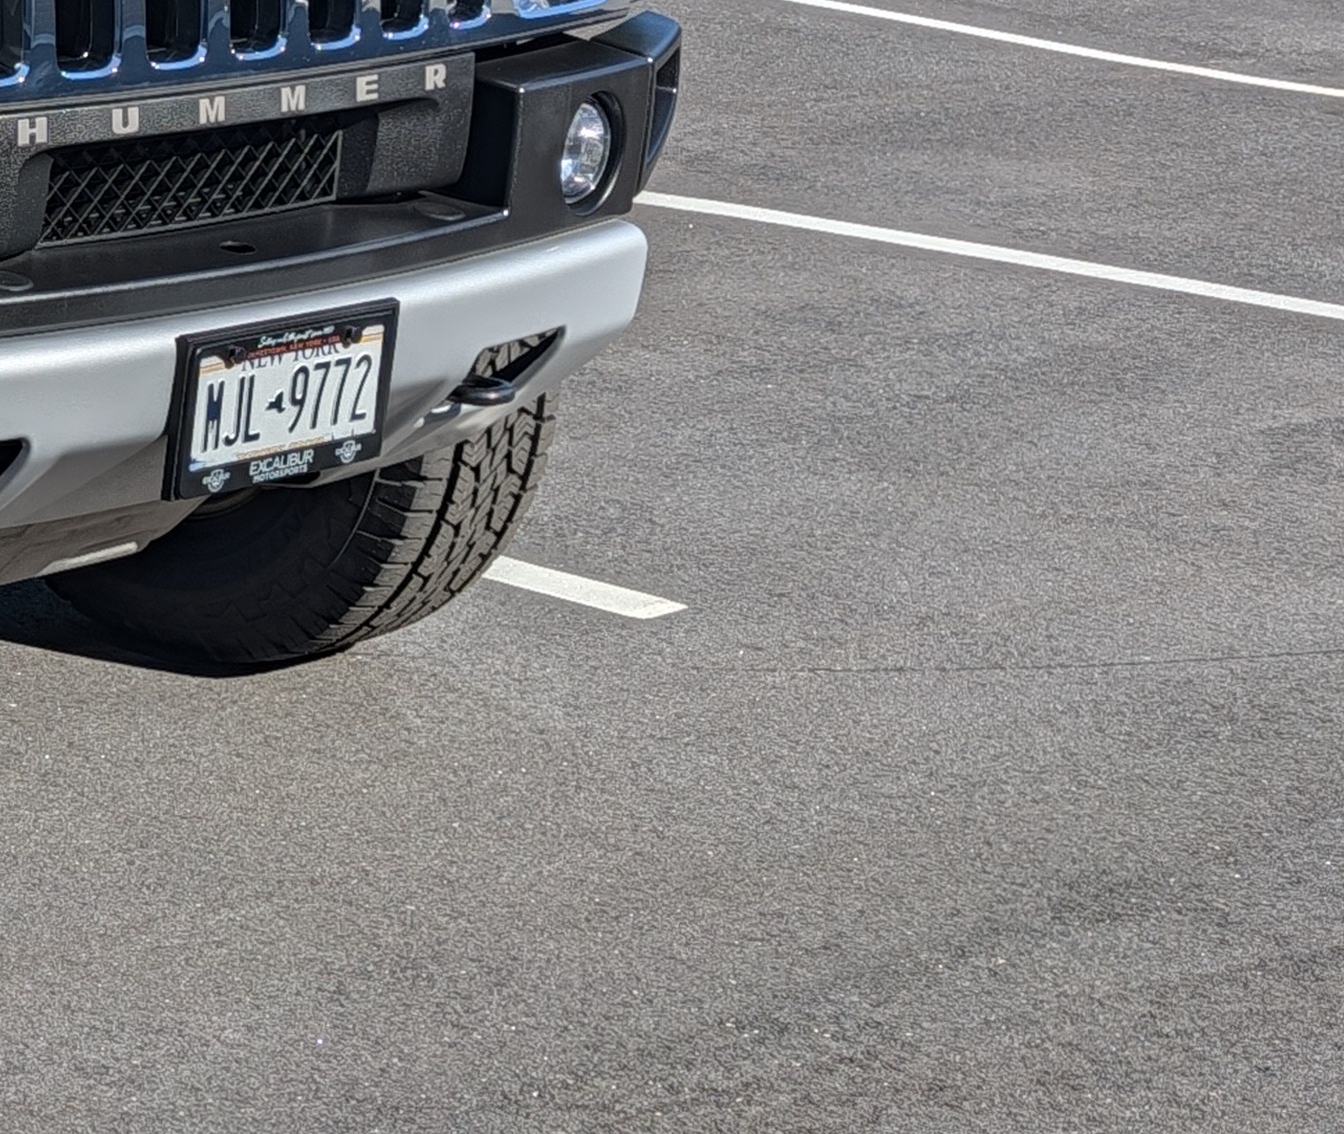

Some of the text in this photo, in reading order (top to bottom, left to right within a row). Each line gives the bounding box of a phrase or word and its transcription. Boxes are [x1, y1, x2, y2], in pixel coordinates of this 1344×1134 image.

[17, 63, 447, 147] HUMMER
[288, 354, 373, 433] 9772
[249, 449, 314, 476] EXCALIBUR
[253, 463, 308, 483] MOTORSPORTS
